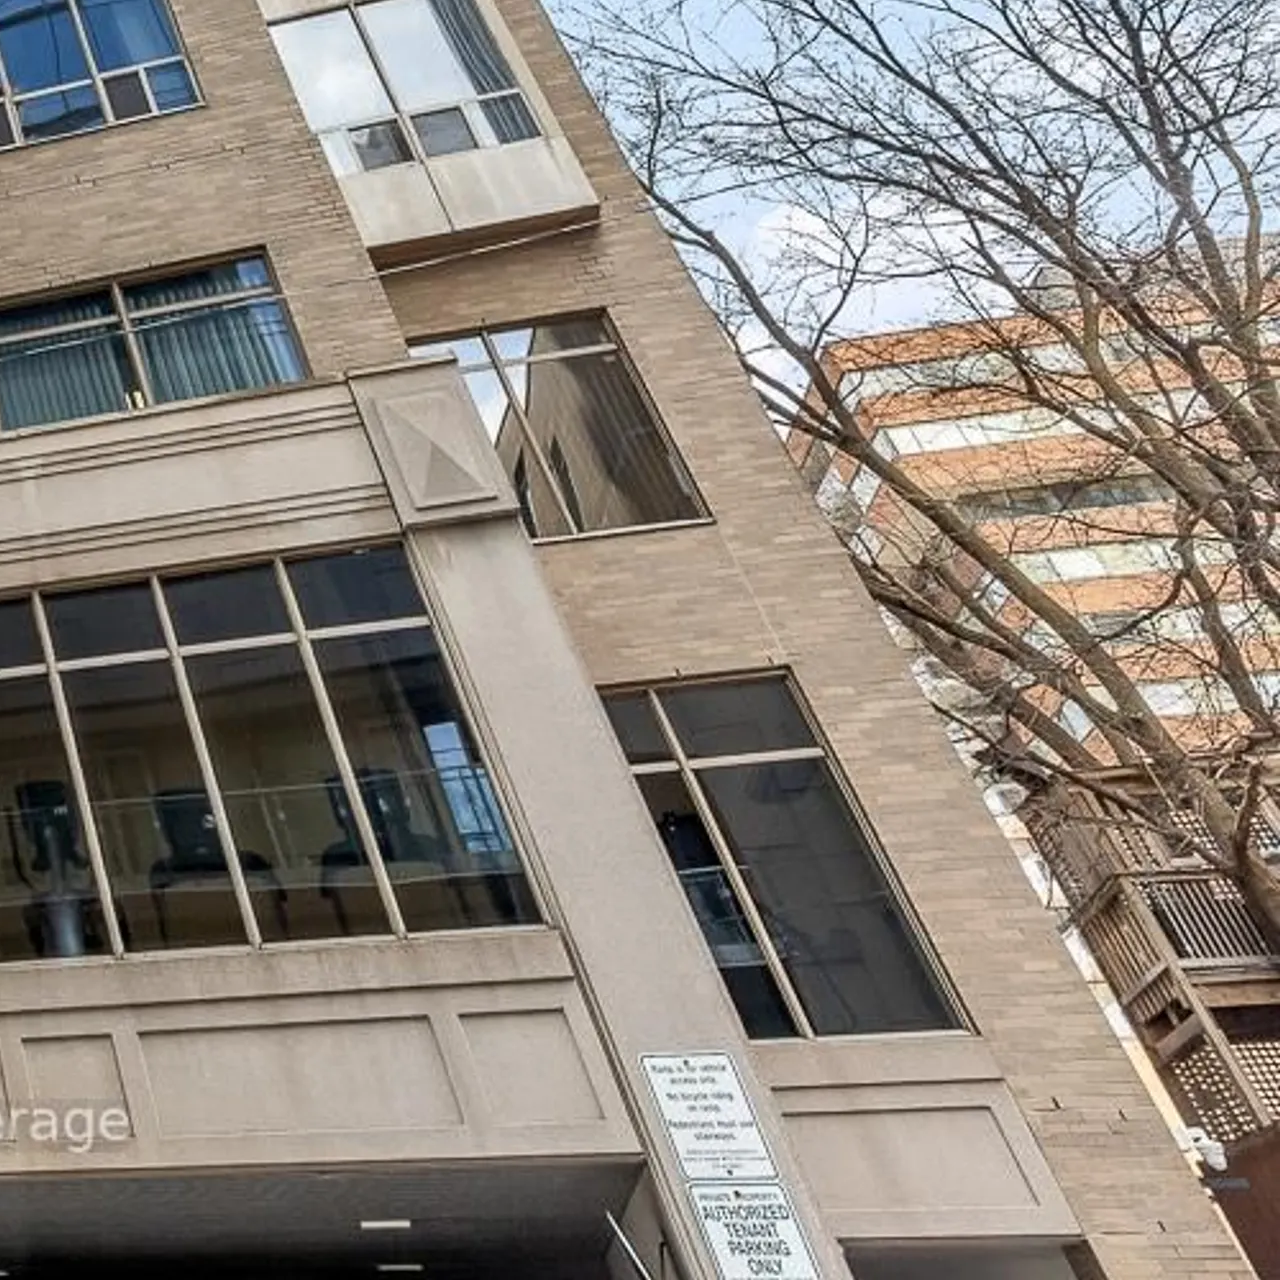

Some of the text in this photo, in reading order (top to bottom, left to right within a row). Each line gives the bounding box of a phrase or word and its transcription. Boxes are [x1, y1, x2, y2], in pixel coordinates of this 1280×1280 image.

[702, 1203, 790, 1222] AUTHORIZED
[722, 1221, 780, 1239] TENANT
[727, 1239, 792, 1257] PARKING
[747, 1257, 783, 1276] ONLY
